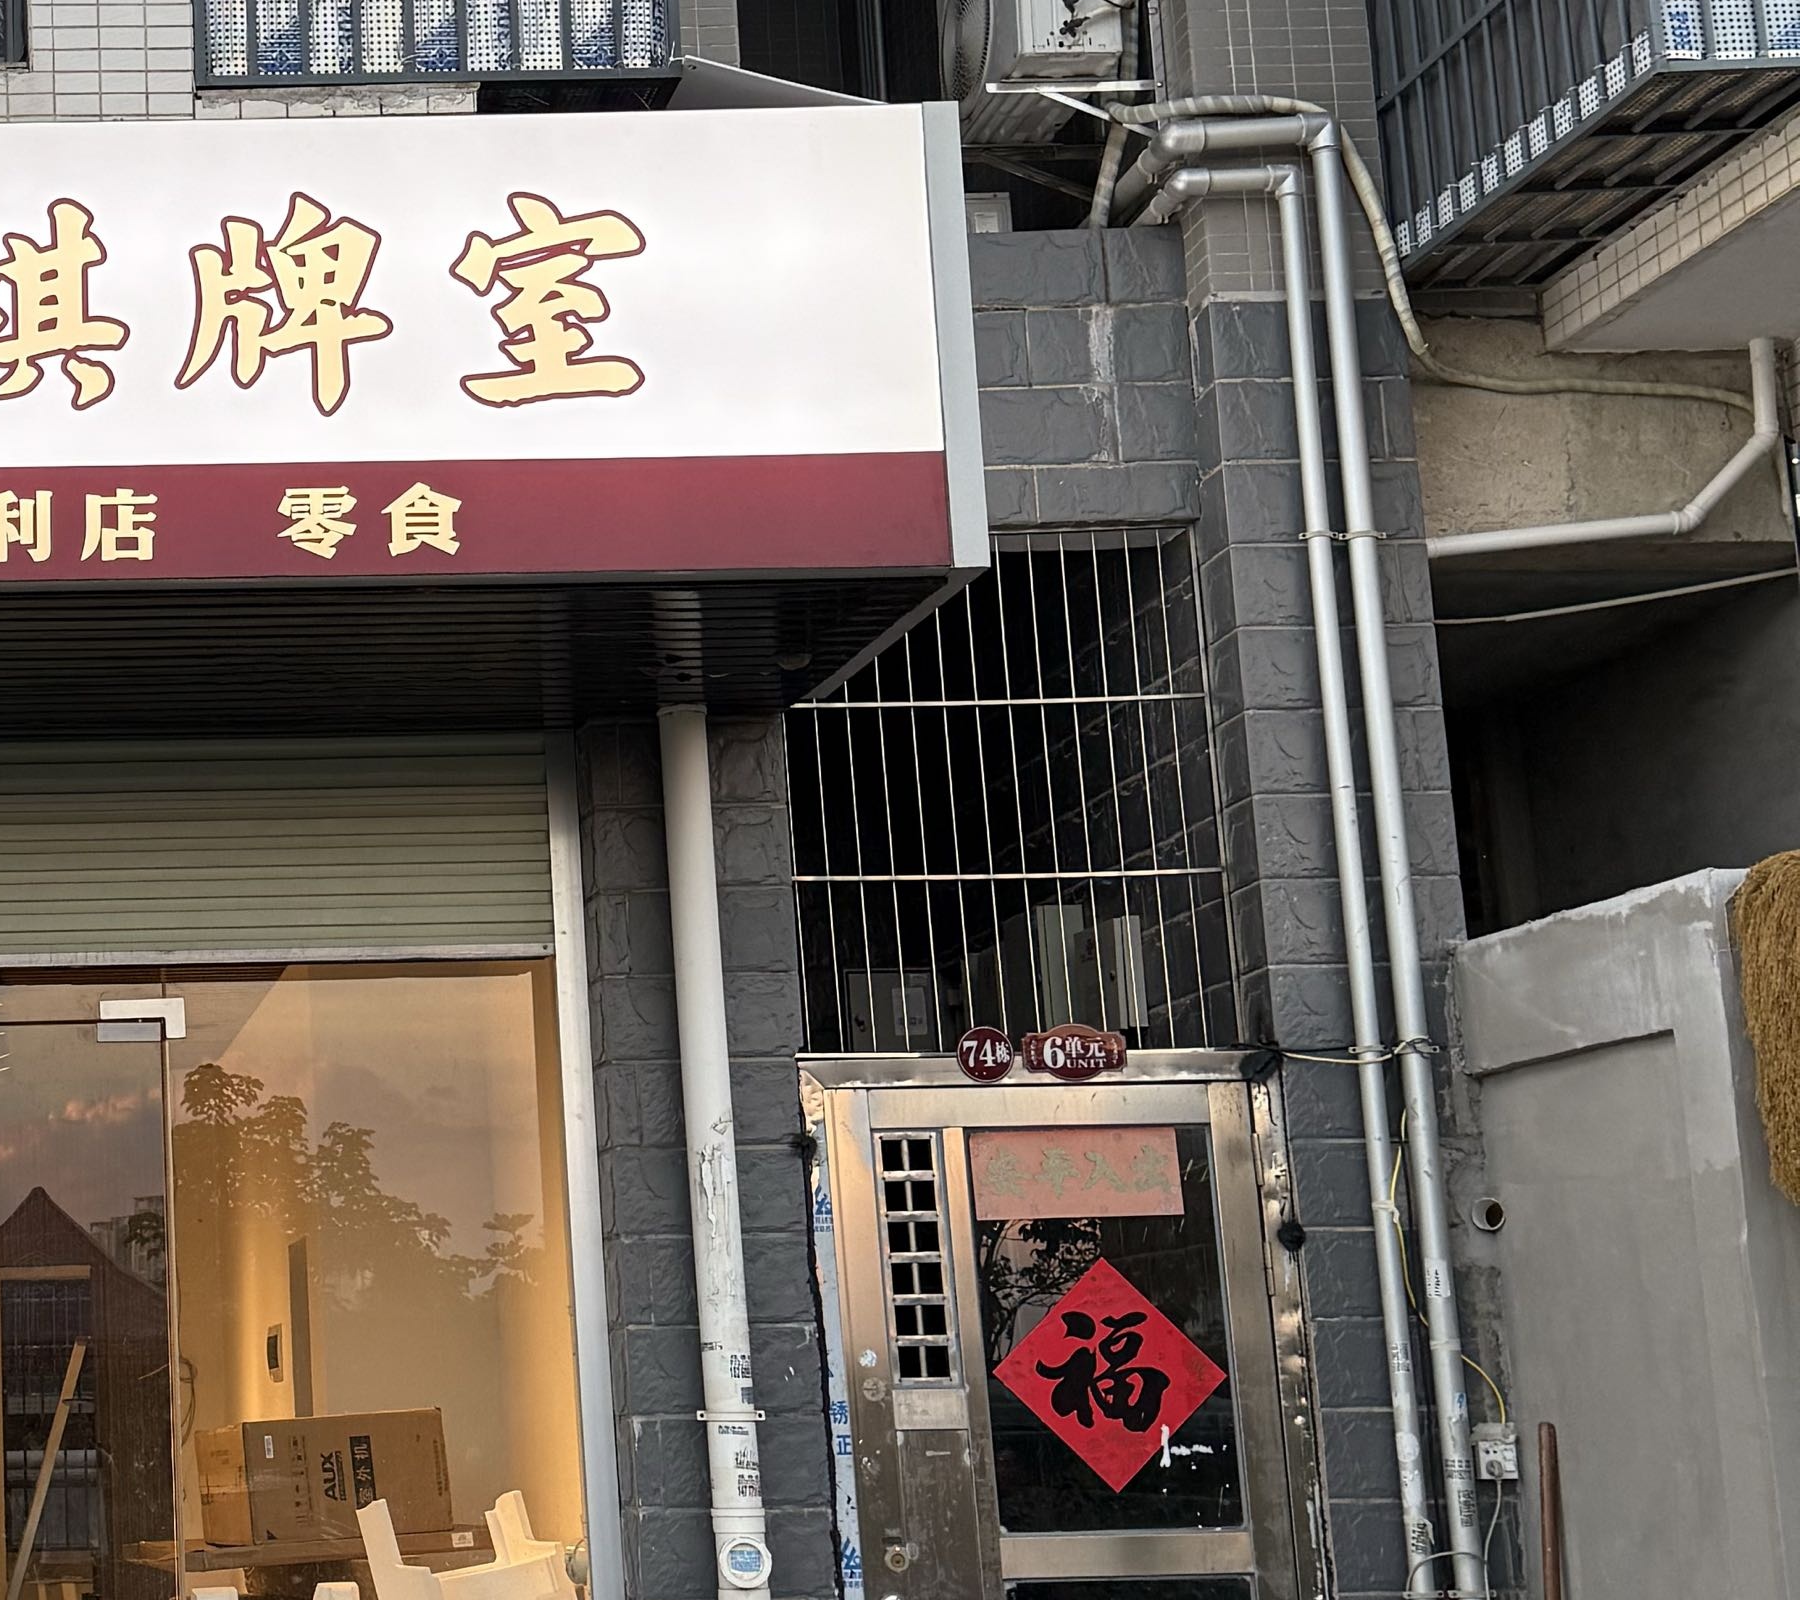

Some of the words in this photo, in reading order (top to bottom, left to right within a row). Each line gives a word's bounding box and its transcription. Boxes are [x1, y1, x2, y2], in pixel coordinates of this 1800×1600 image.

[277, 482, 462, 560] 零食
[963, 1040, 1011, 1067] 74栋
[1066, 1058, 1107, 1068] UNIT
[1035, 1310, 1171, 1432] 福
[320, 1453, 337, 1500] AUX
